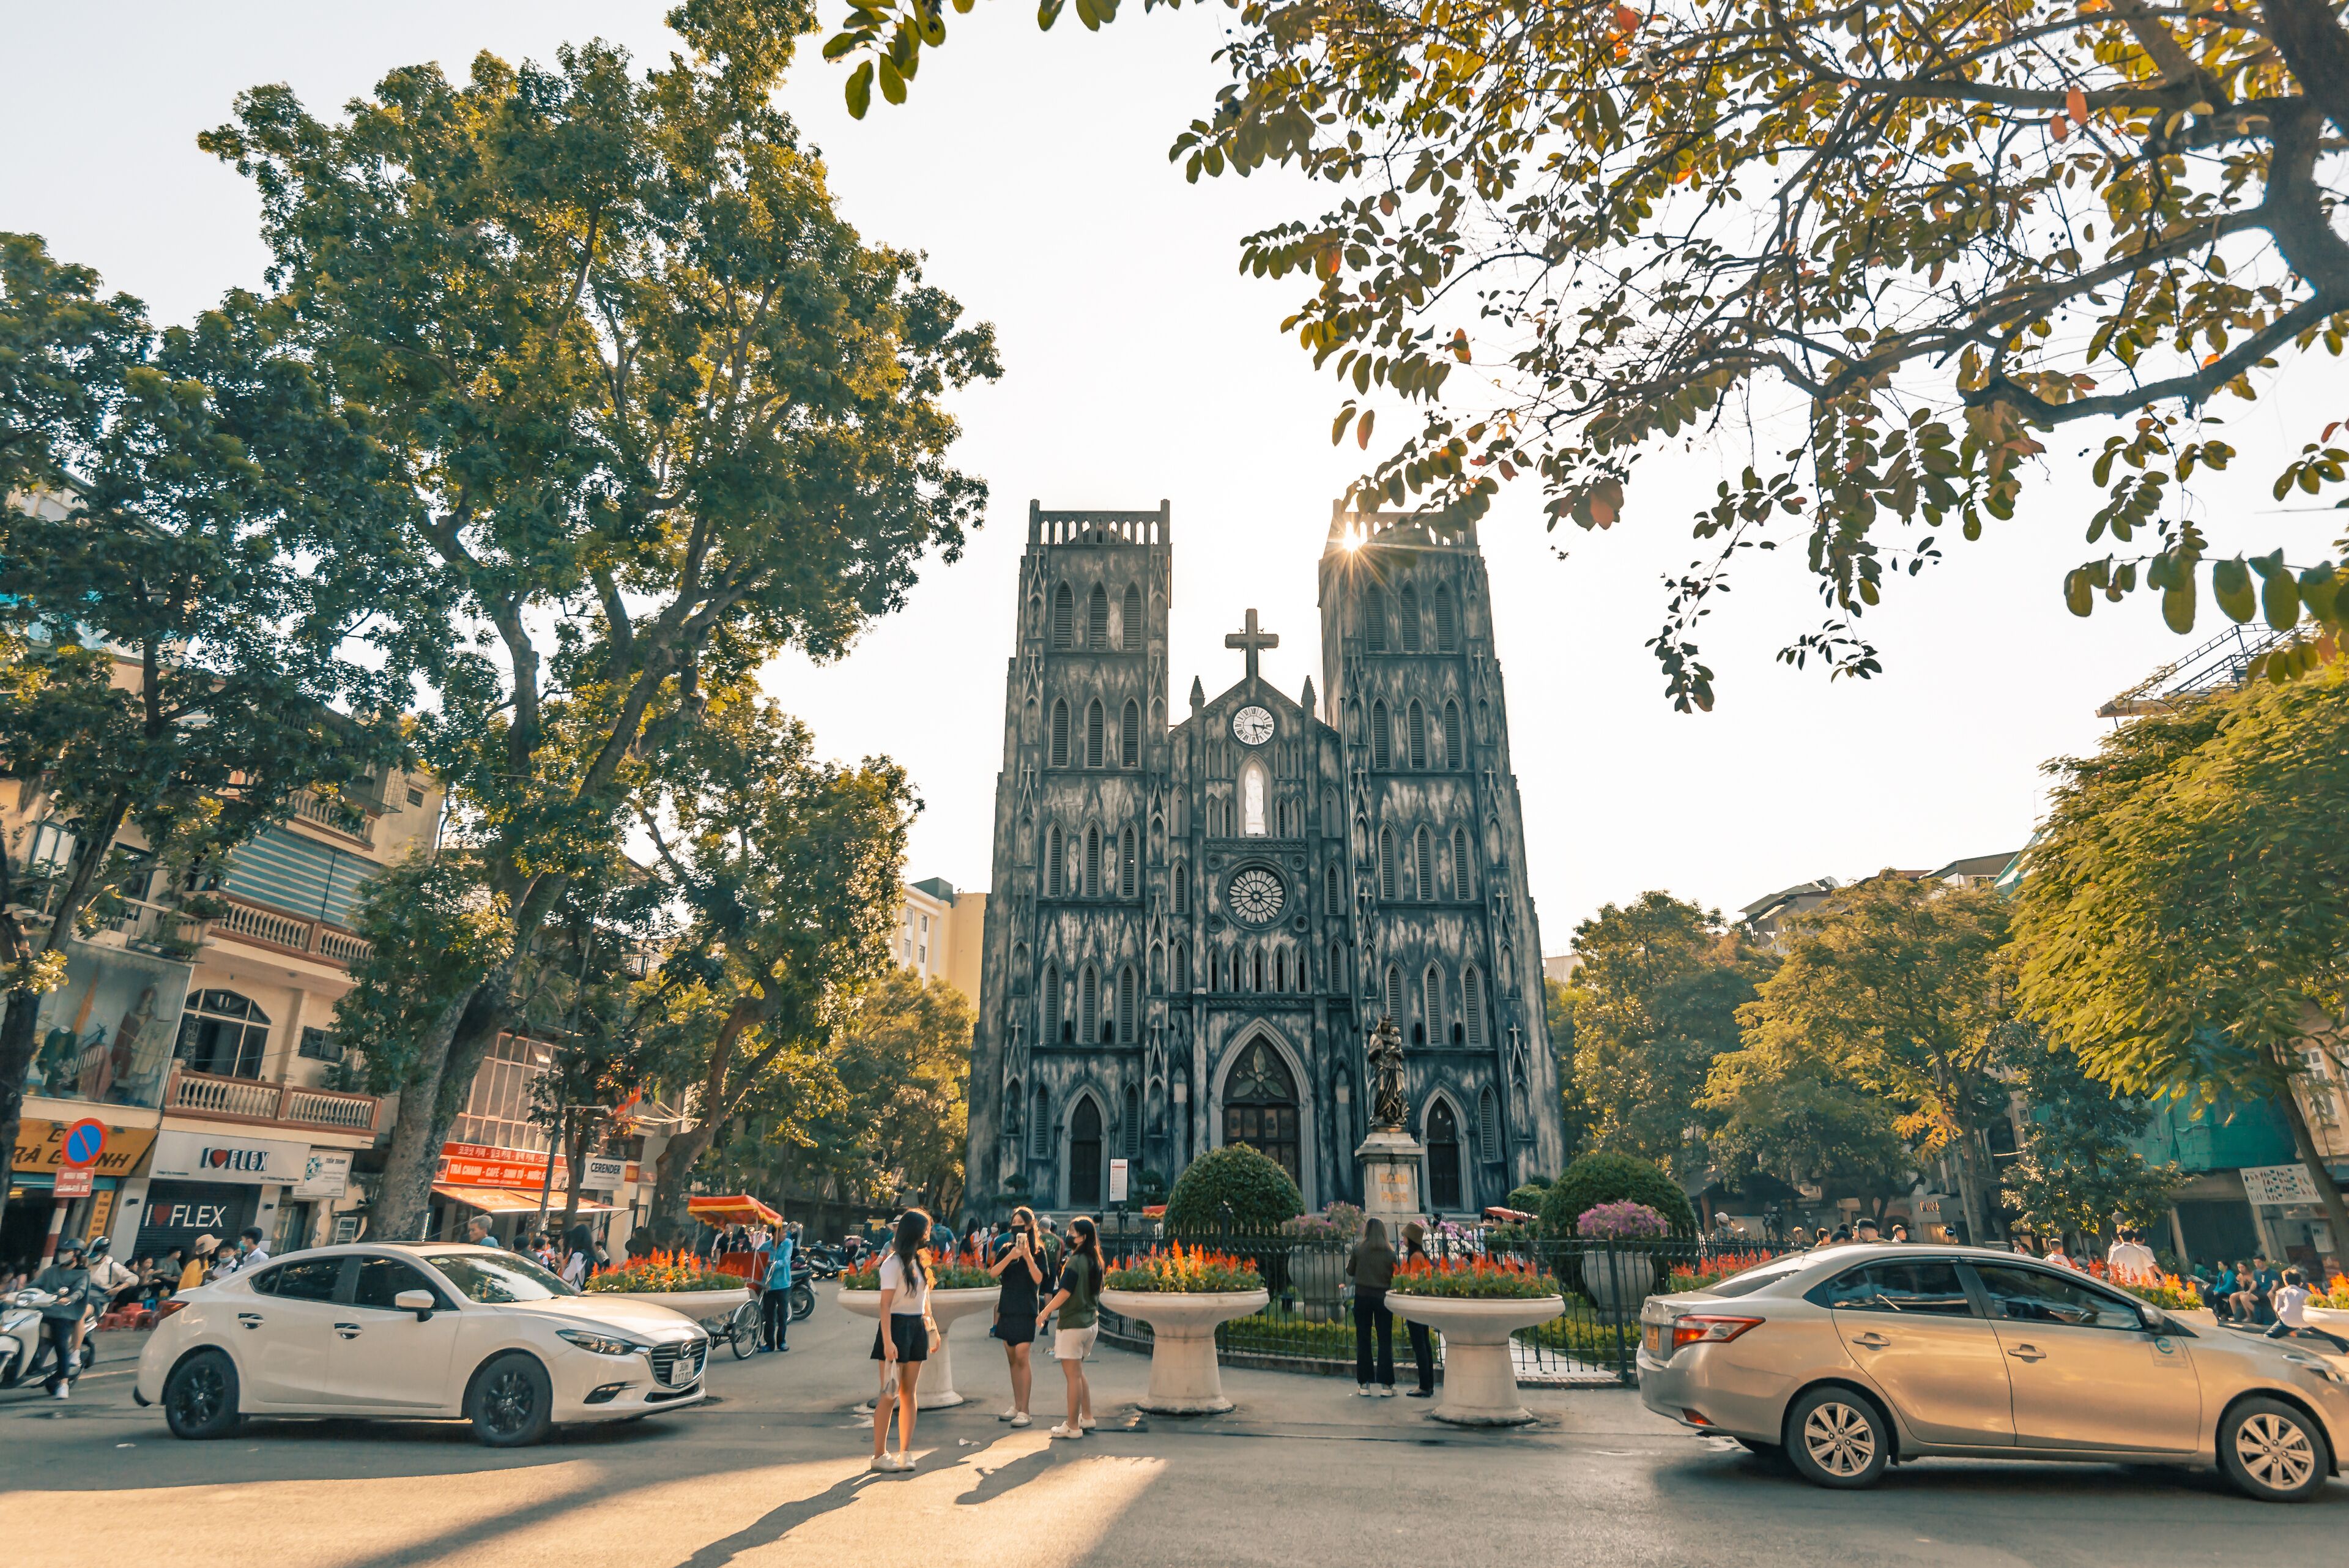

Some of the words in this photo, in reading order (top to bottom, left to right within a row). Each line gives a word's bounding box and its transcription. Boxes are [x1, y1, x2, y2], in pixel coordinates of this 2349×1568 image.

[47, 1150, 132, 1168] CNH
[201, 1148, 212, 1168] I
[225, 1149, 270, 1172] FLEX
[485, 1166, 500, 1178] CAFÉ
[590, 1162, 621, 1175] CERENDER
[145, 1203, 153, 1227] I
[169, 1205, 227, 1228] FLEX
